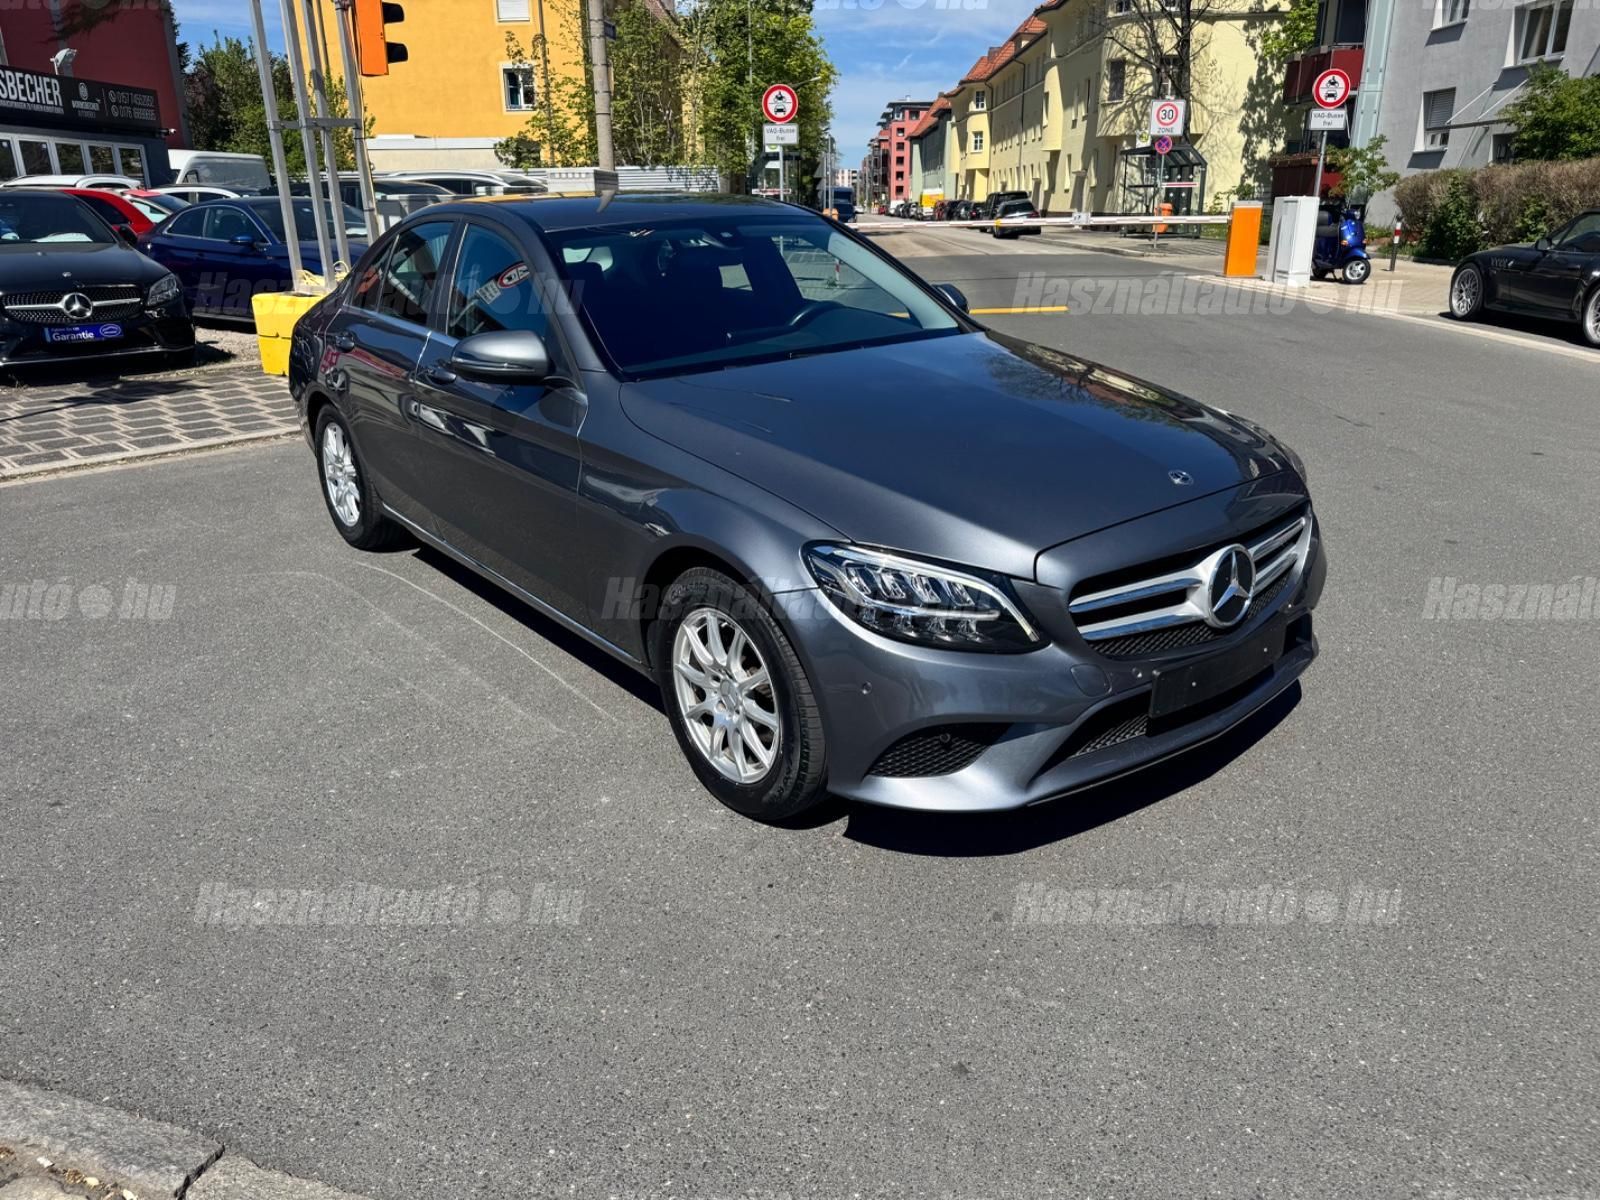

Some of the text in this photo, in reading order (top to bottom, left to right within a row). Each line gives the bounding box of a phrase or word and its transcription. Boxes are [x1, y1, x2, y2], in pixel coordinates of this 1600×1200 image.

[0, 70, 63, 106] SBECHER
[1160, 109, 1174, 121] 30
[52, 330, 94, 341] Garantie
